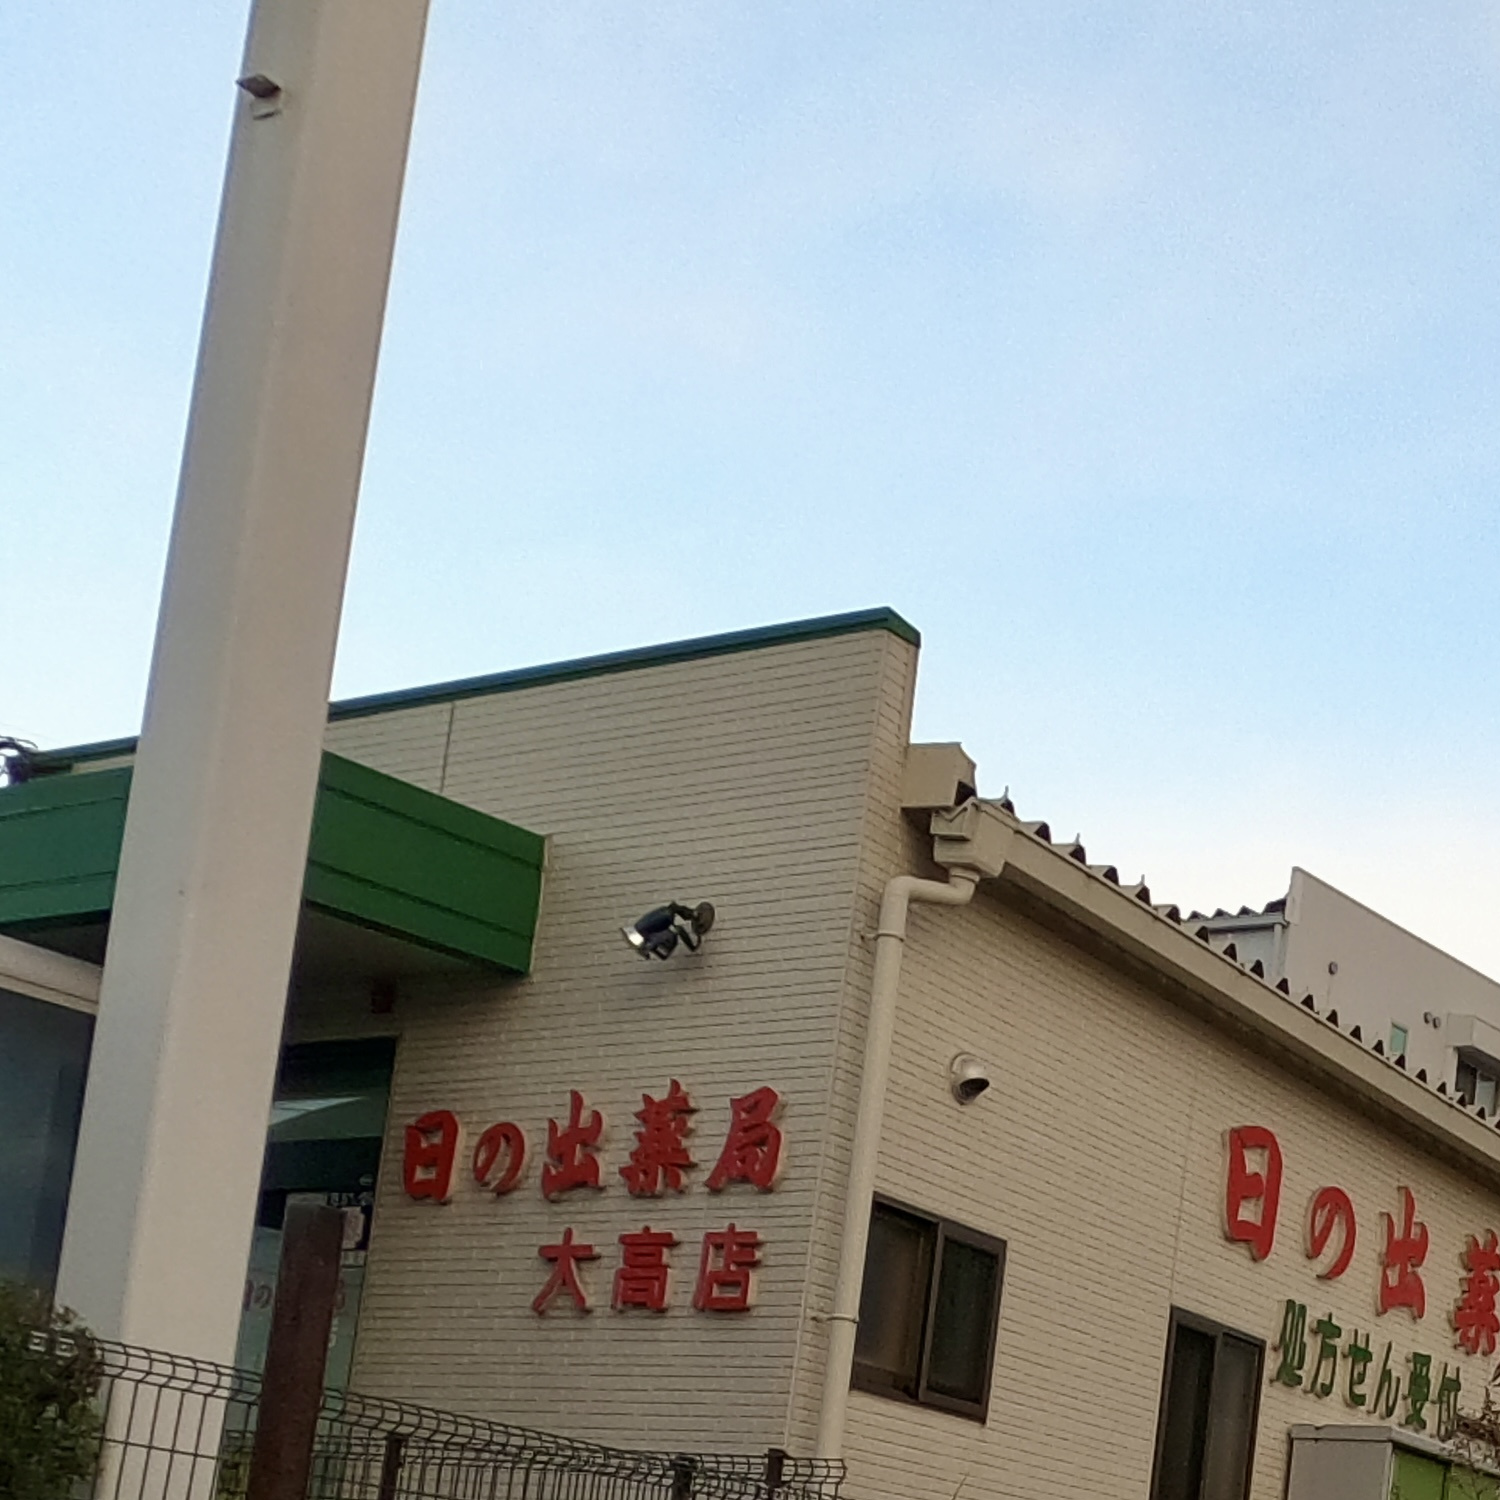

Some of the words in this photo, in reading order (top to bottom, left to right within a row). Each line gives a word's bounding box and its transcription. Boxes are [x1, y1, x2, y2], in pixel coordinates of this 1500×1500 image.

[402, 1078, 788, 1204] 日の出薬局
[531, 1223, 765, 1316] 大高店
[1272, 1298, 1462, 1443] 処方せん受付
